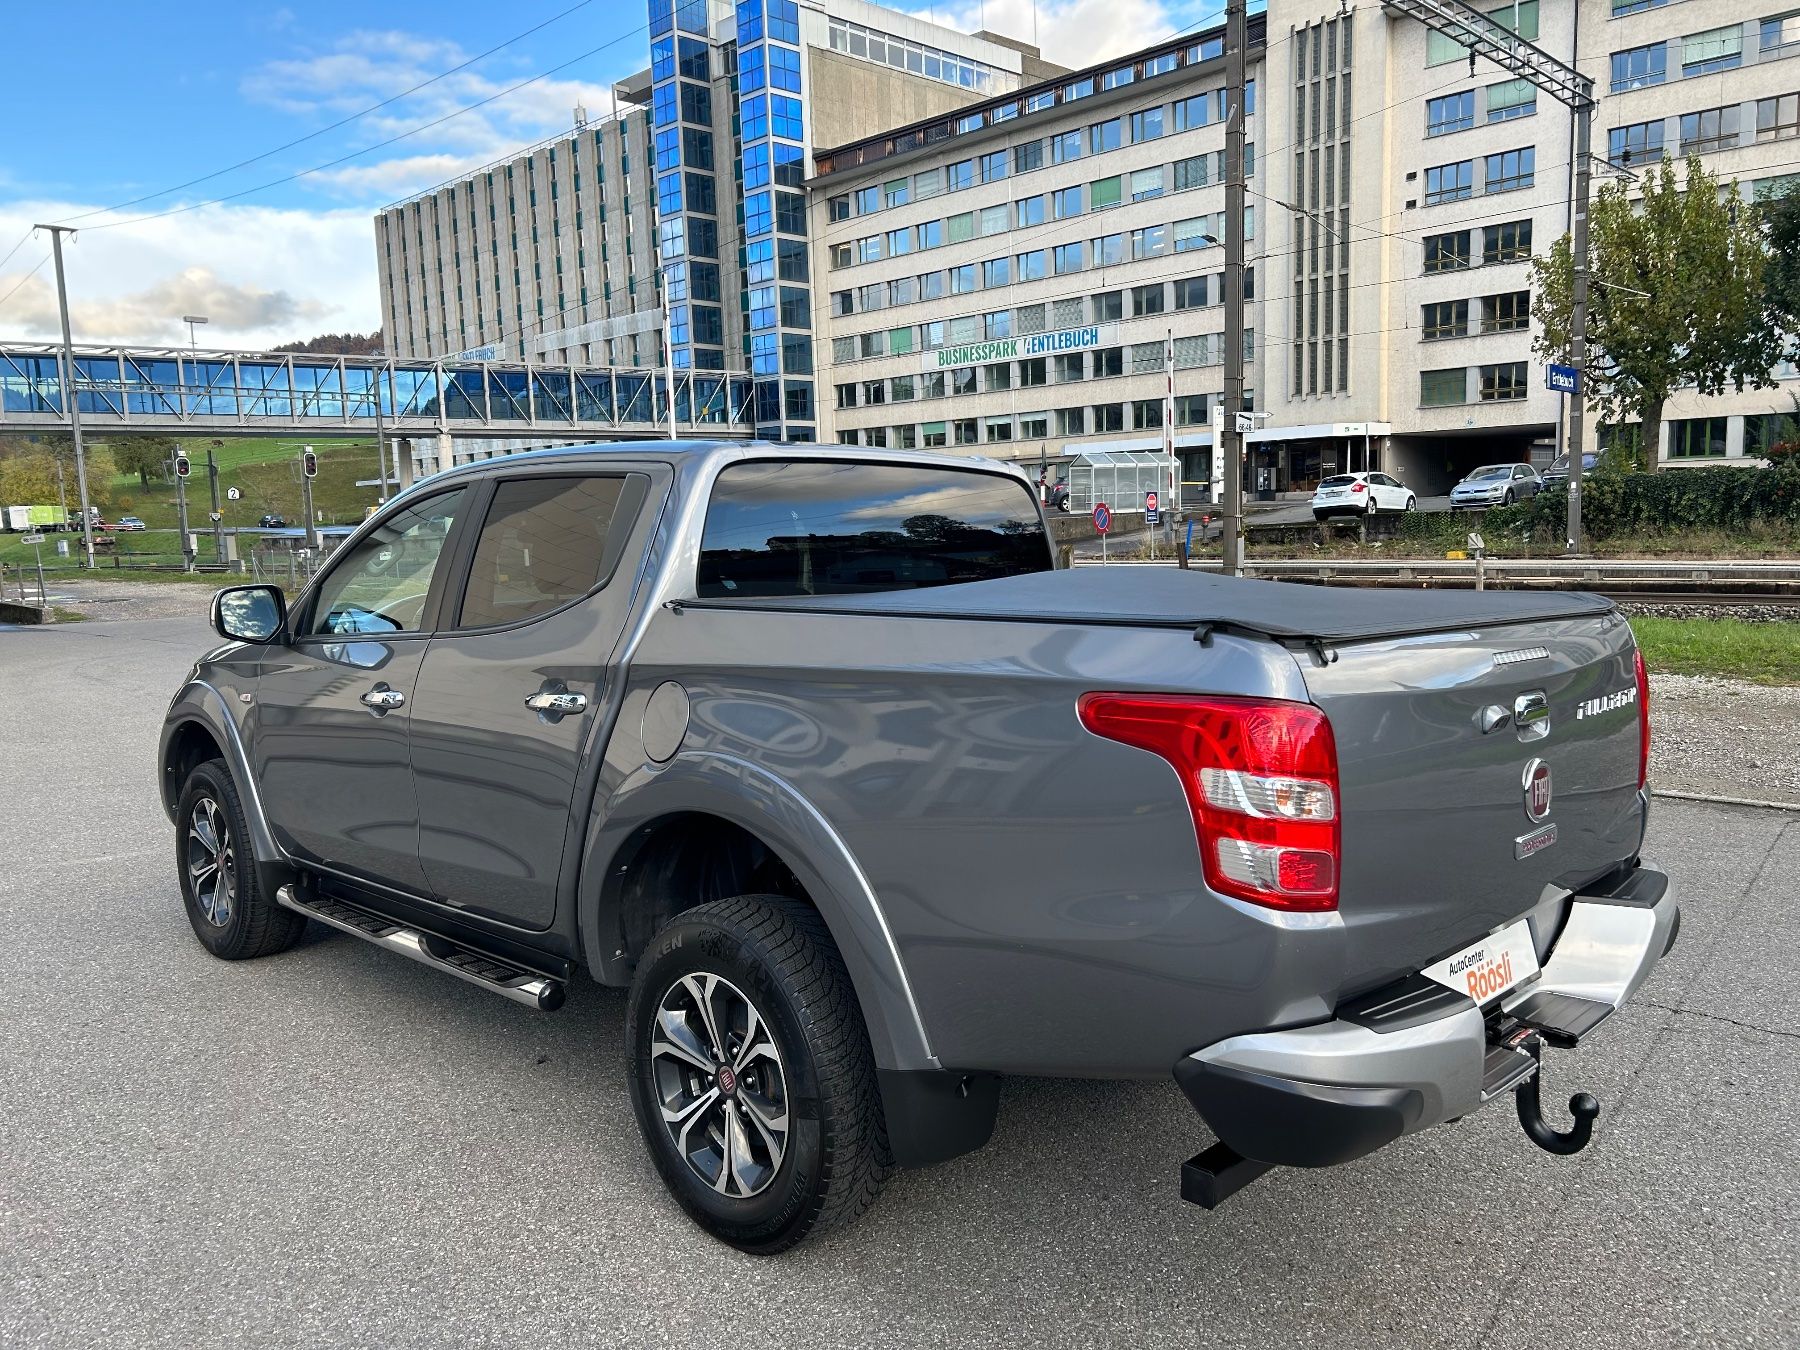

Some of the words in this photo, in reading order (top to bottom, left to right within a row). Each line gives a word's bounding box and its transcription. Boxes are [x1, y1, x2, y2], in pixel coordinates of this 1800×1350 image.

[938, 340, 1017, 366] BUSINESSPARK
[1032, 327, 1099, 354] ENTLEBUCH
[1552, 372, 1574, 388] Entlebuch
[230, 489, 237, 499] 2
[1534, 776, 1550, 807] FIAT
[1449, 949, 1485, 977] AutoCenter
[1466, 951, 1513, 1001] Röösli
